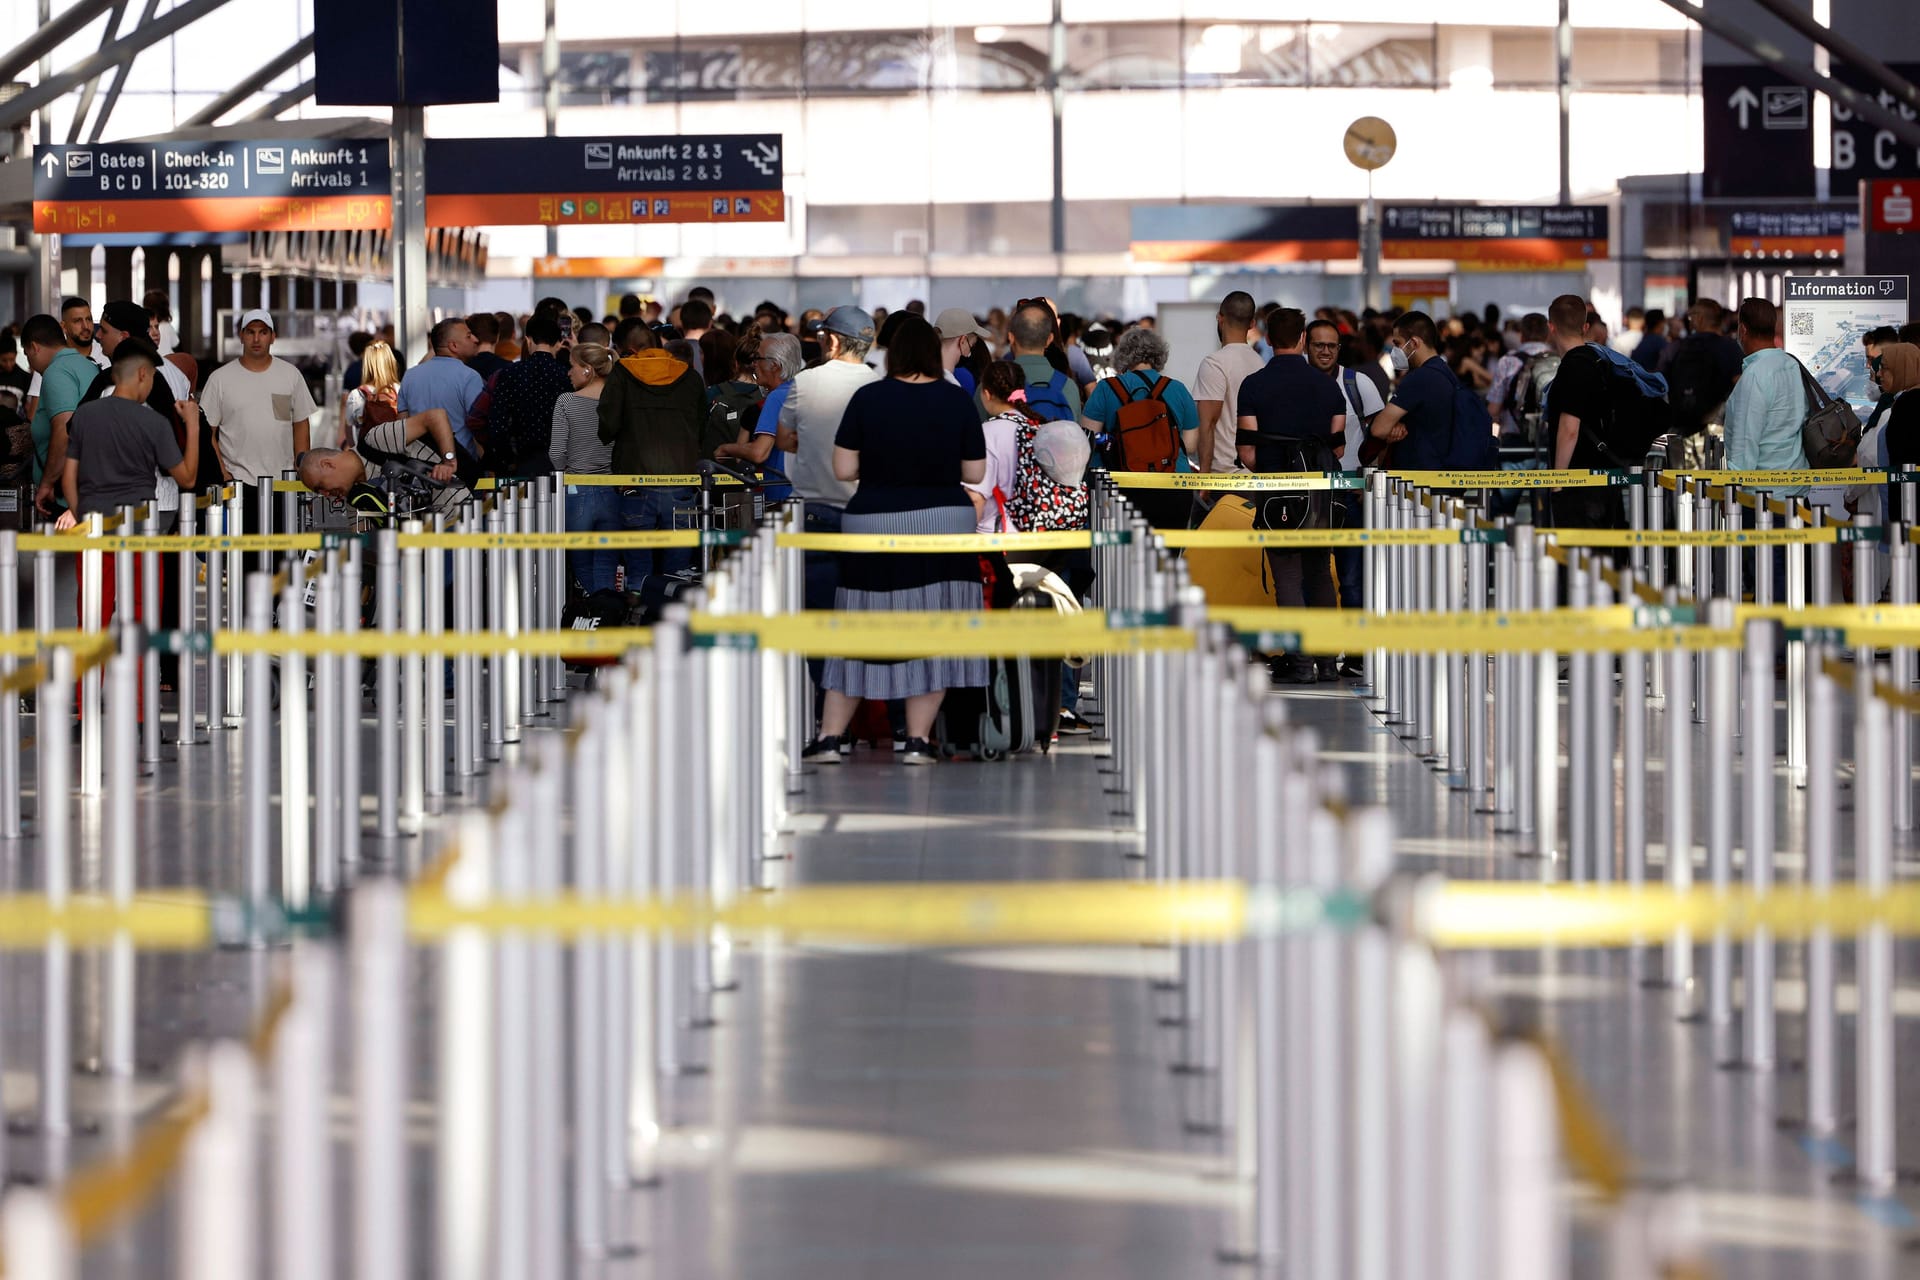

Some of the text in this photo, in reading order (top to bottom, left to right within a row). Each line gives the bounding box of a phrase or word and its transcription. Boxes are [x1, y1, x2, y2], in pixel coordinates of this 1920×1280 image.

[290, 148, 368, 165] Ankunft 1
[617, 144, 722, 161] Ankunft 2 & 3
[1833, 130, 1856, 170] B
[1874, 129, 1897, 170] C
[100, 153, 145, 168] Gates
[164, 151, 234, 168] Check-in
[164, 172, 229, 190] 101-320
[290, 171, 367, 187] Arrivals 1
[617, 165, 722, 181] Arrivals 2 & 3
[100, 174, 141, 190] B C D
[1790, 282, 1875, 296] Information
[571, 616, 601, 631] NIKE
